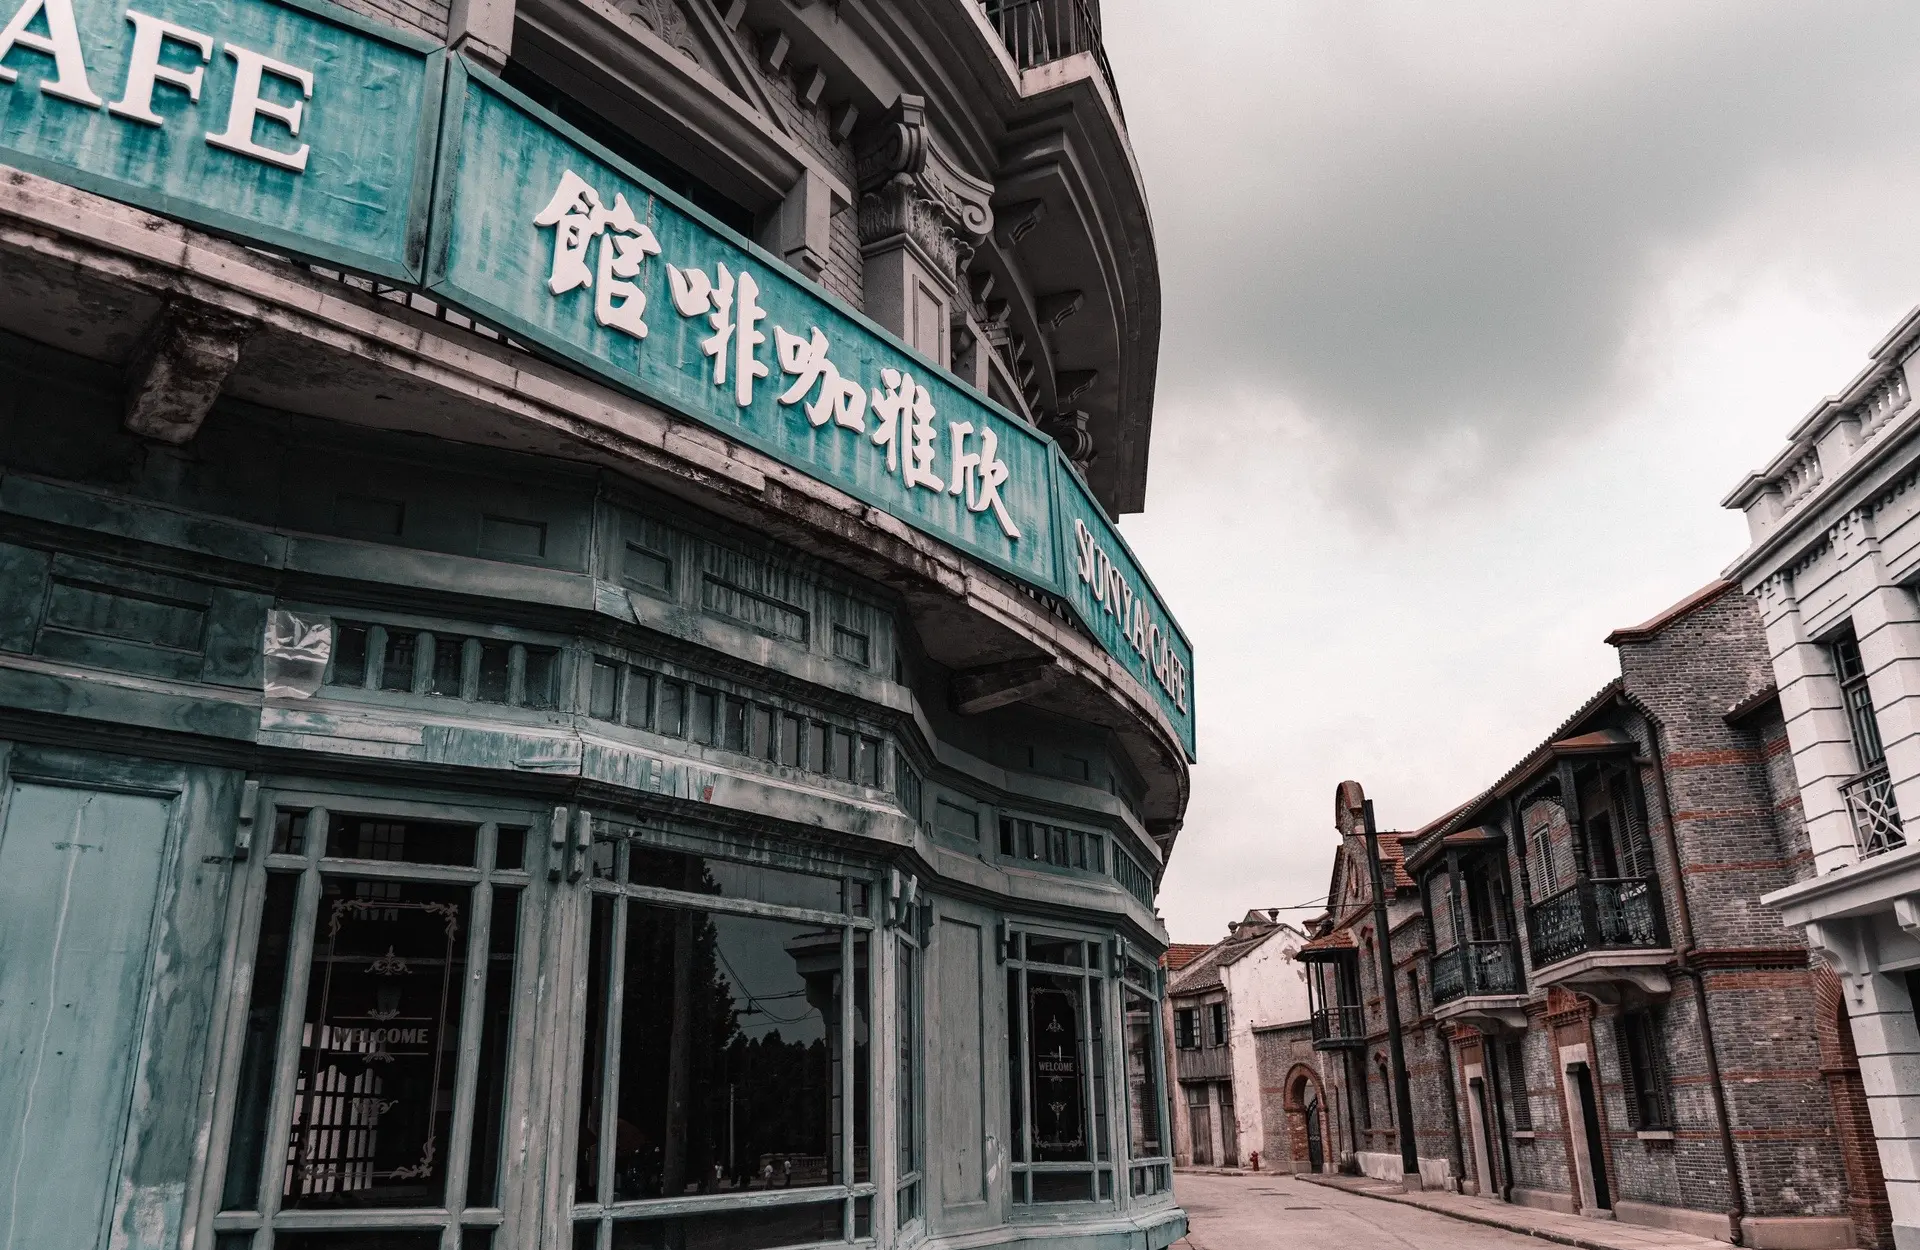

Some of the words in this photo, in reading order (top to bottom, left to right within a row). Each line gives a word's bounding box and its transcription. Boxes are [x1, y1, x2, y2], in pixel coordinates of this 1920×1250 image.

[1075, 518, 1147, 663] SUNYA
[1149, 623, 1187, 715] CAFE
[333, 1027, 429, 1044] WELCOME
[1039, 1061, 1074, 1072] WELCOME
